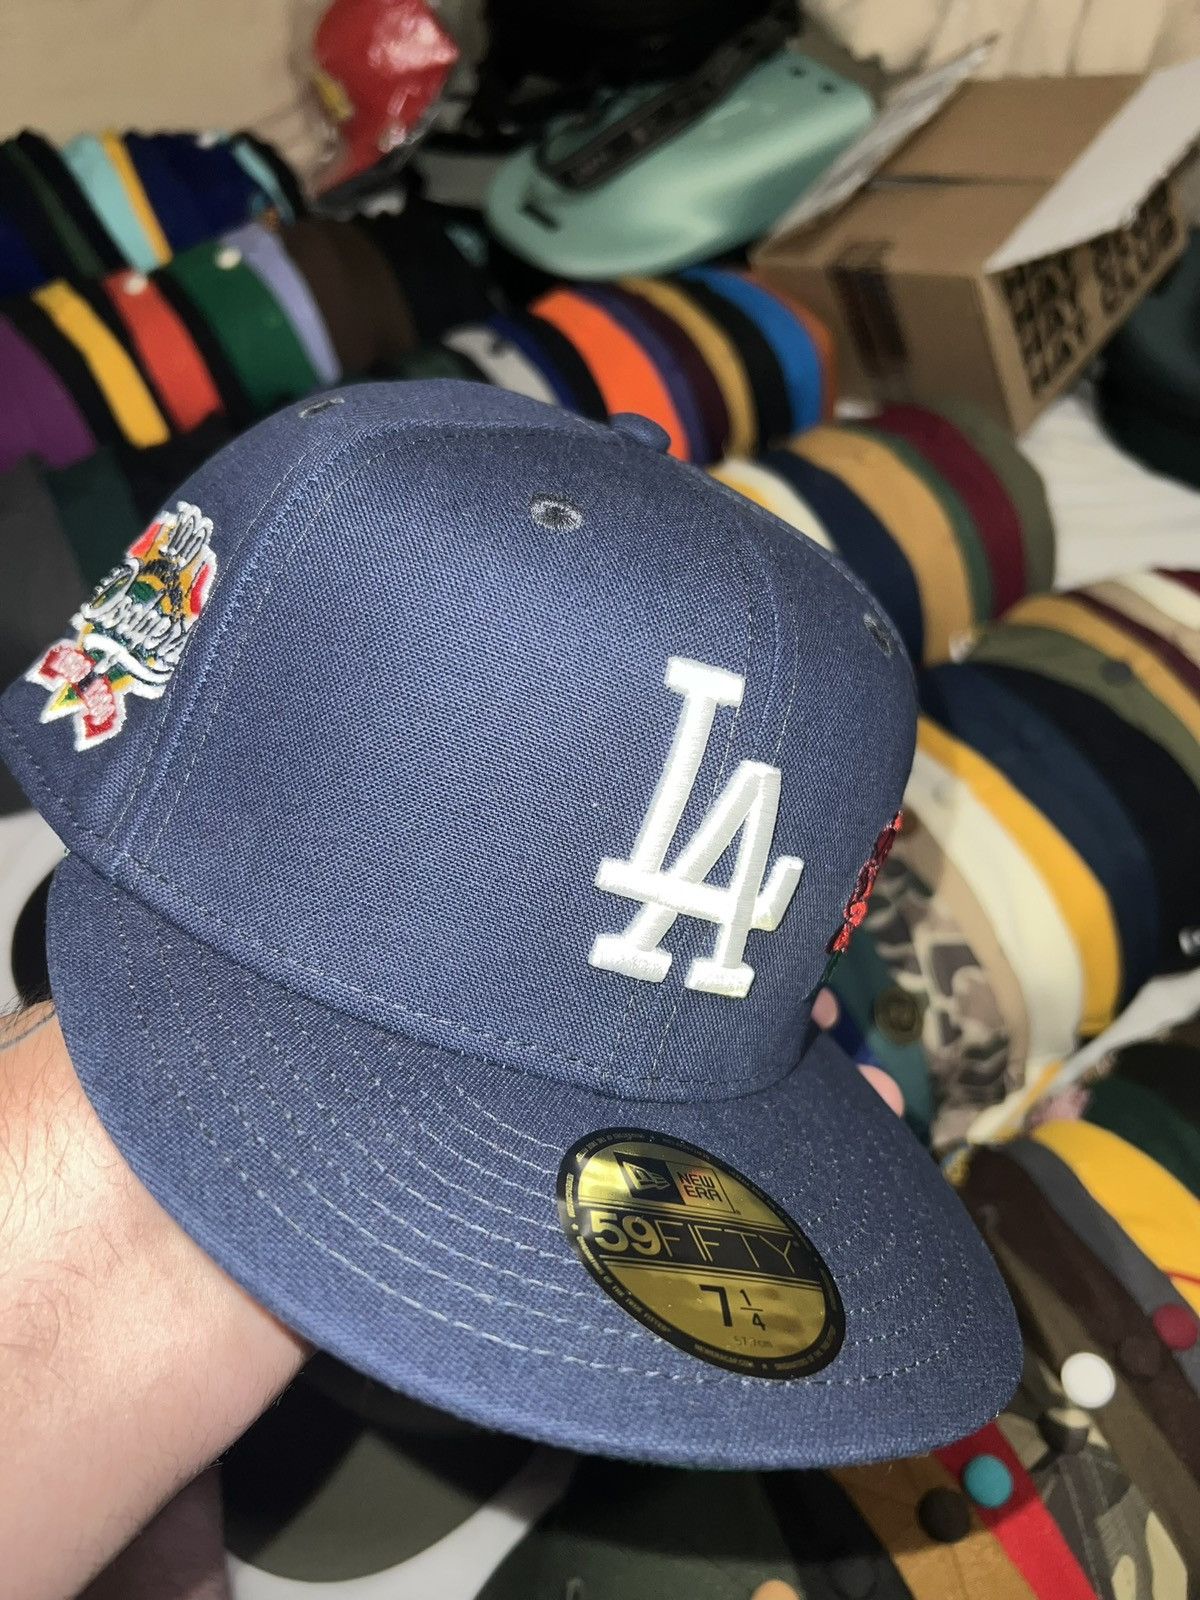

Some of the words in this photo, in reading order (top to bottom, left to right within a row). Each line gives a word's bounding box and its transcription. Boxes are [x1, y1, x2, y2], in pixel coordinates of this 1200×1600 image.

[589, 657, 804, 999] LA
[677, 1171, 715, 1189] NEW
[686, 1184, 722, 1203] ERA
[590, 1210, 795, 1274] 59FIFTY
[699, 1284, 733, 1327] 7
